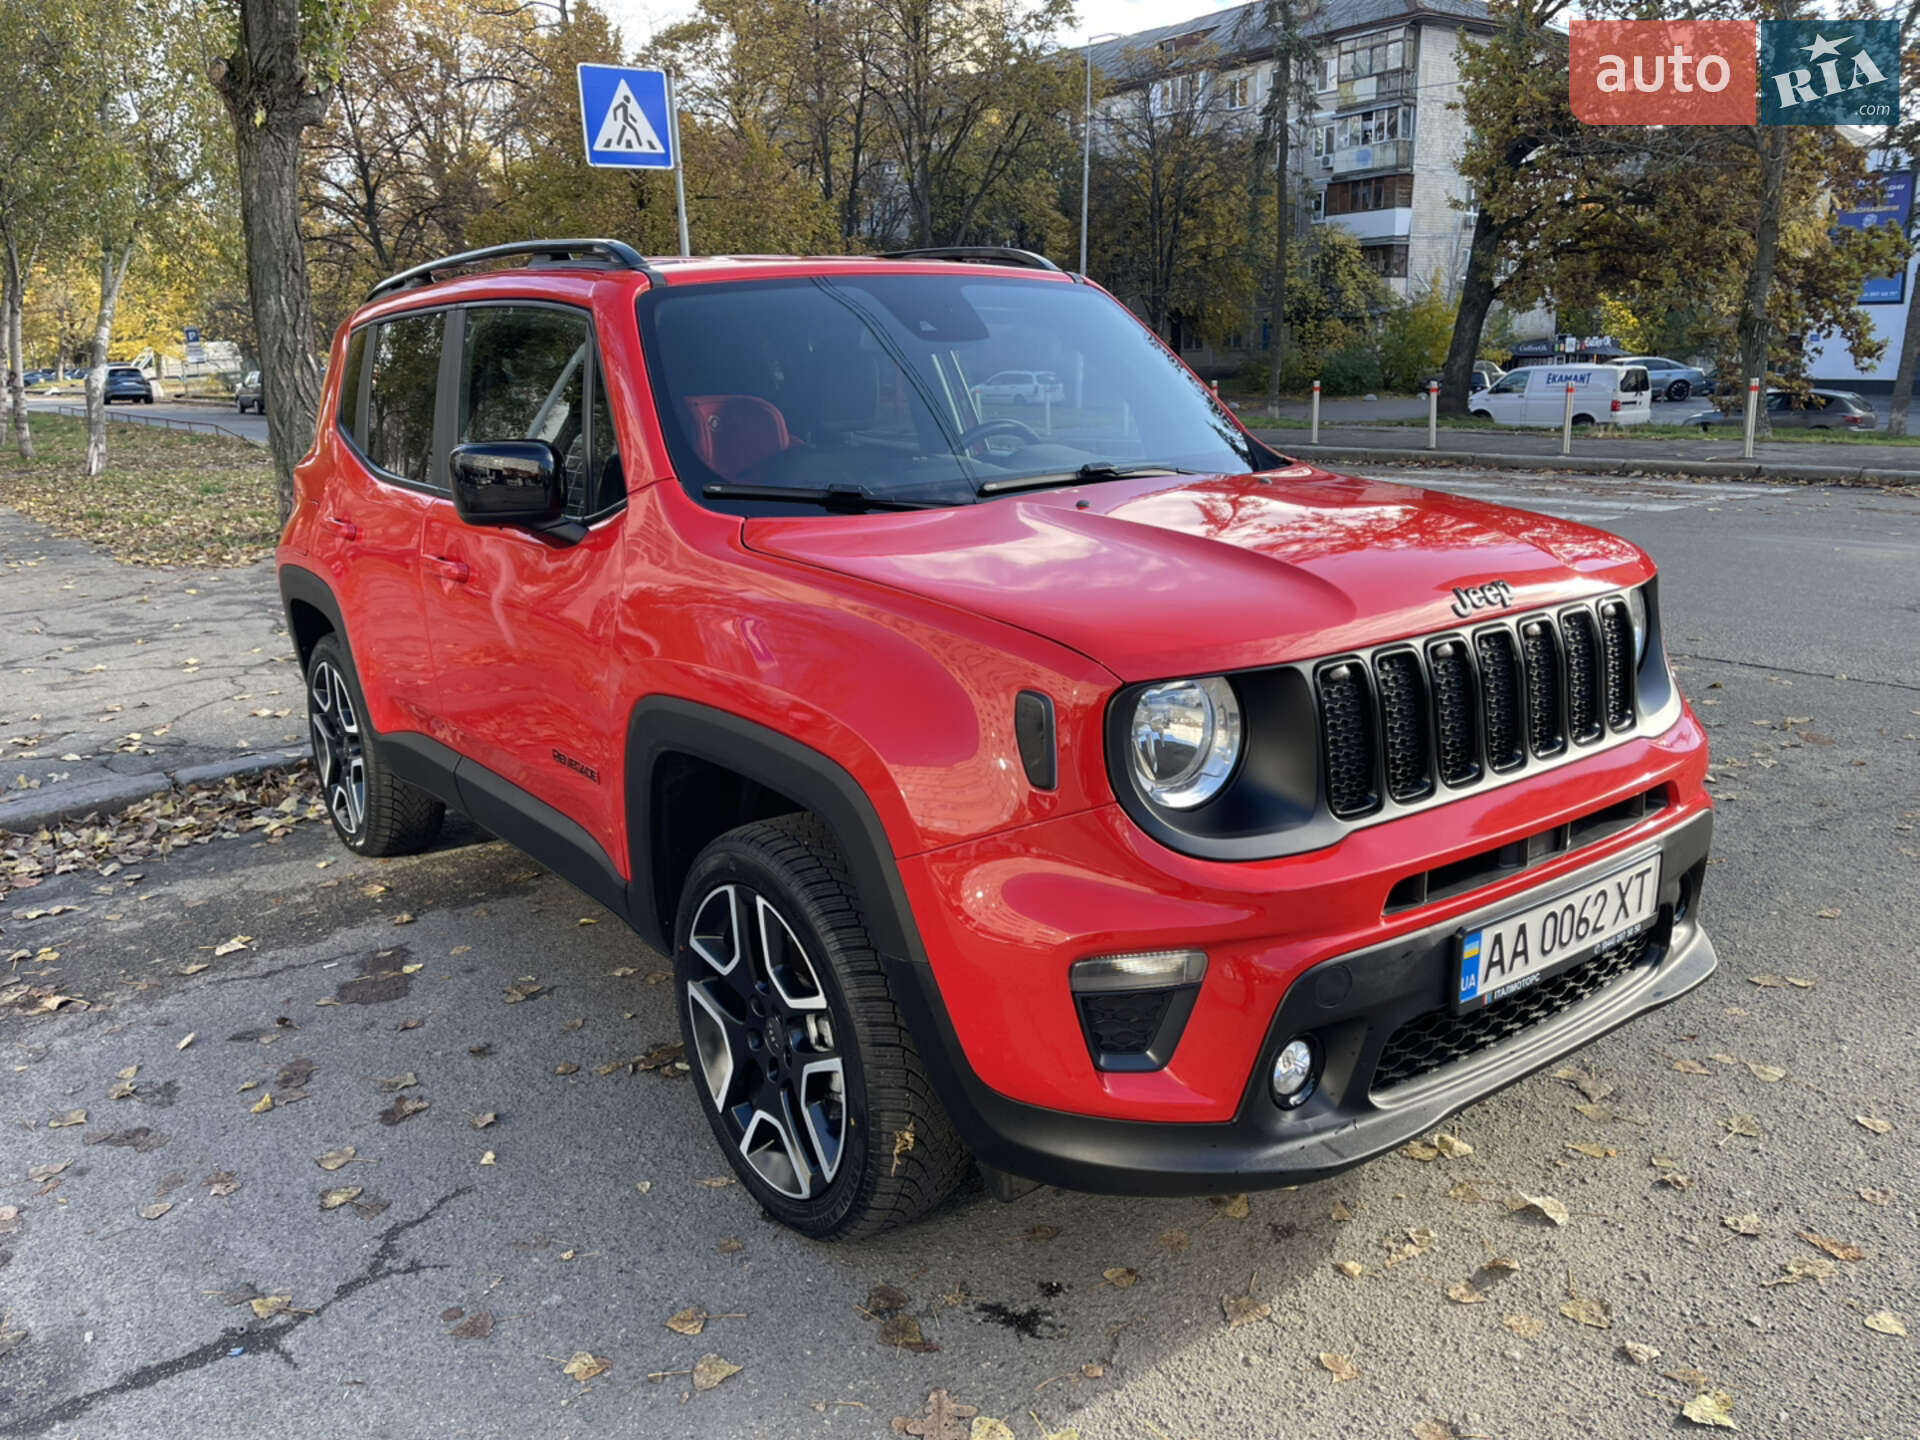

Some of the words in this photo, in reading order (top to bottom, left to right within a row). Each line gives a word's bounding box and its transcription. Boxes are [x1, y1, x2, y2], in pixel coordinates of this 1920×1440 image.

[1545, 372, 1592, 385] EKAMANT
[1451, 579, 1515, 618] Jeep
[1483, 922, 1529, 983] AA
[1540, 889, 1608, 957] 0062
[1612, 866, 1652, 926] XT
[1460, 973, 1476, 992] UA
